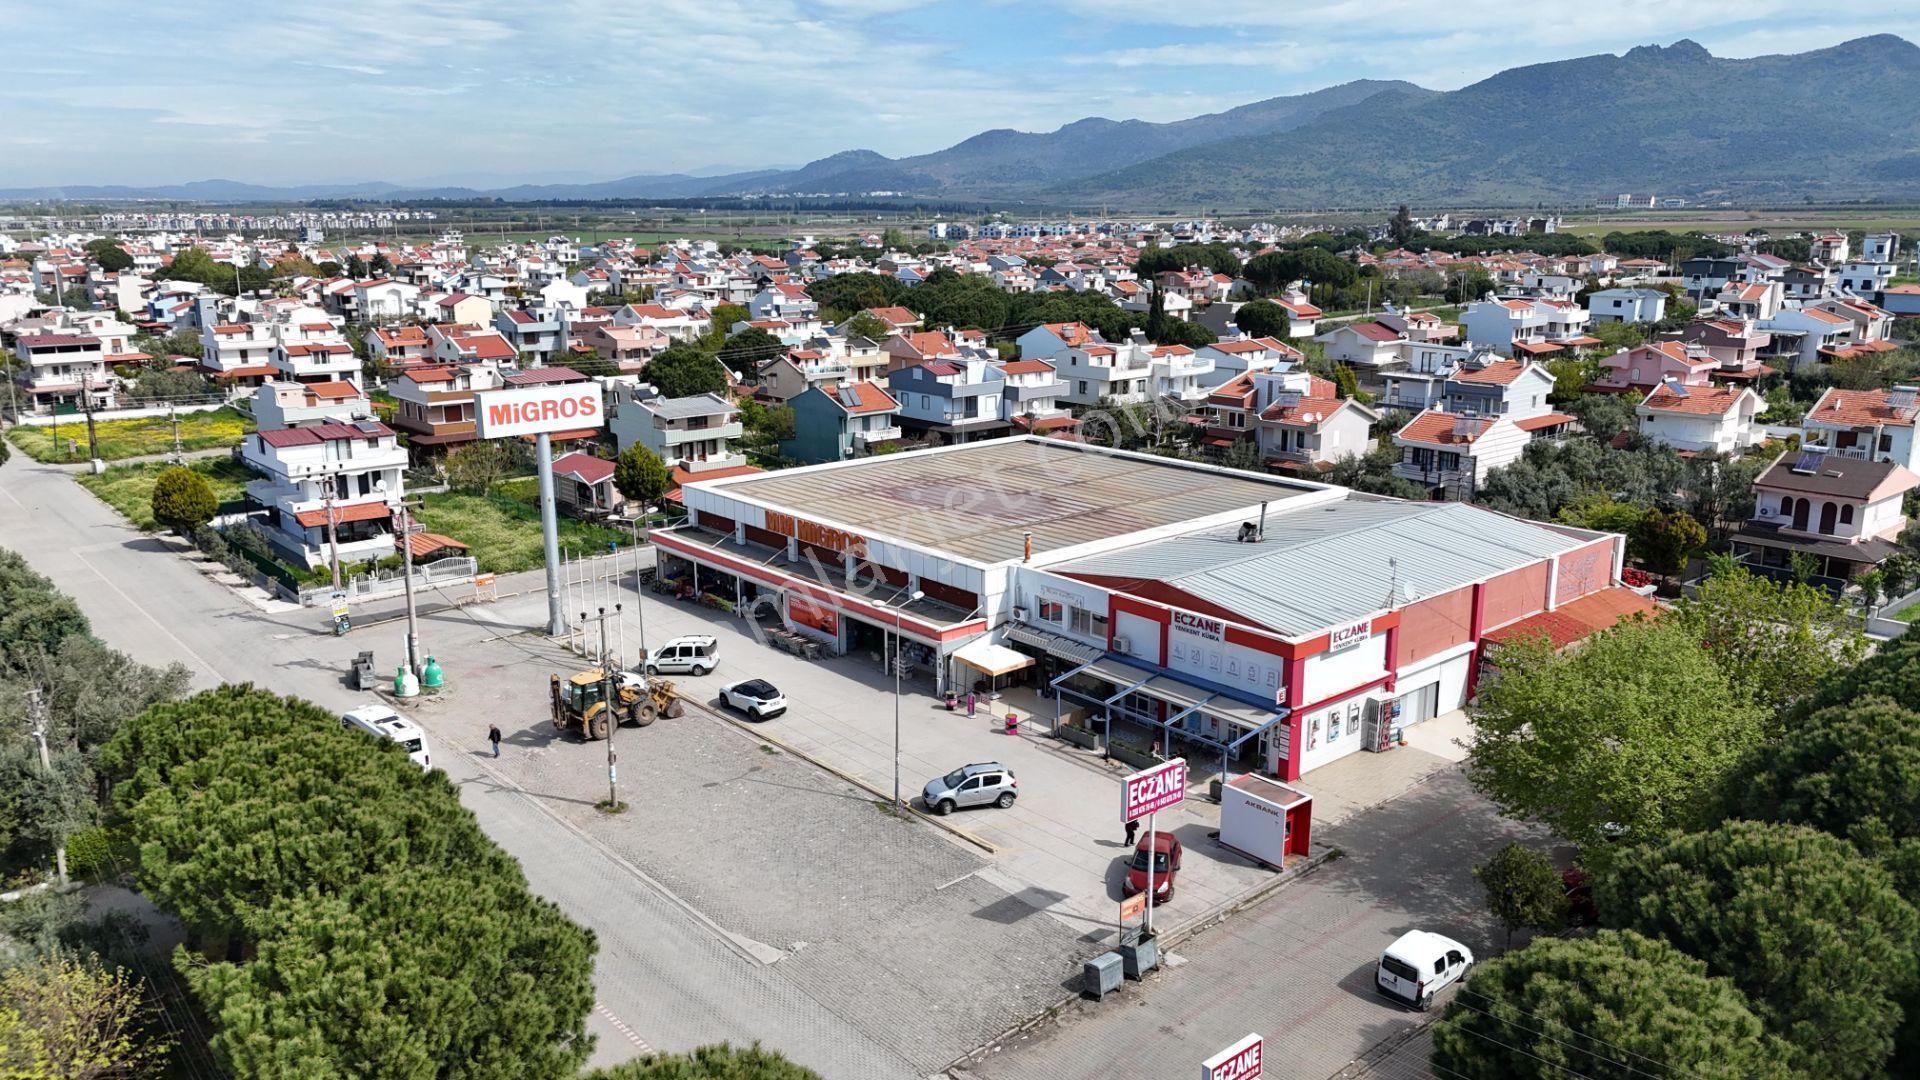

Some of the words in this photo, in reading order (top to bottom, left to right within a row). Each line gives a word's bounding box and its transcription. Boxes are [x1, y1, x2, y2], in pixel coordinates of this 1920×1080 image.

[1175, 612, 1220, 634] ECZANE
[1333, 621, 1370, 643] ECZANE
[1129, 766, 1183, 807] ECZANE
[1245, 800, 1280, 818] AKBANK
